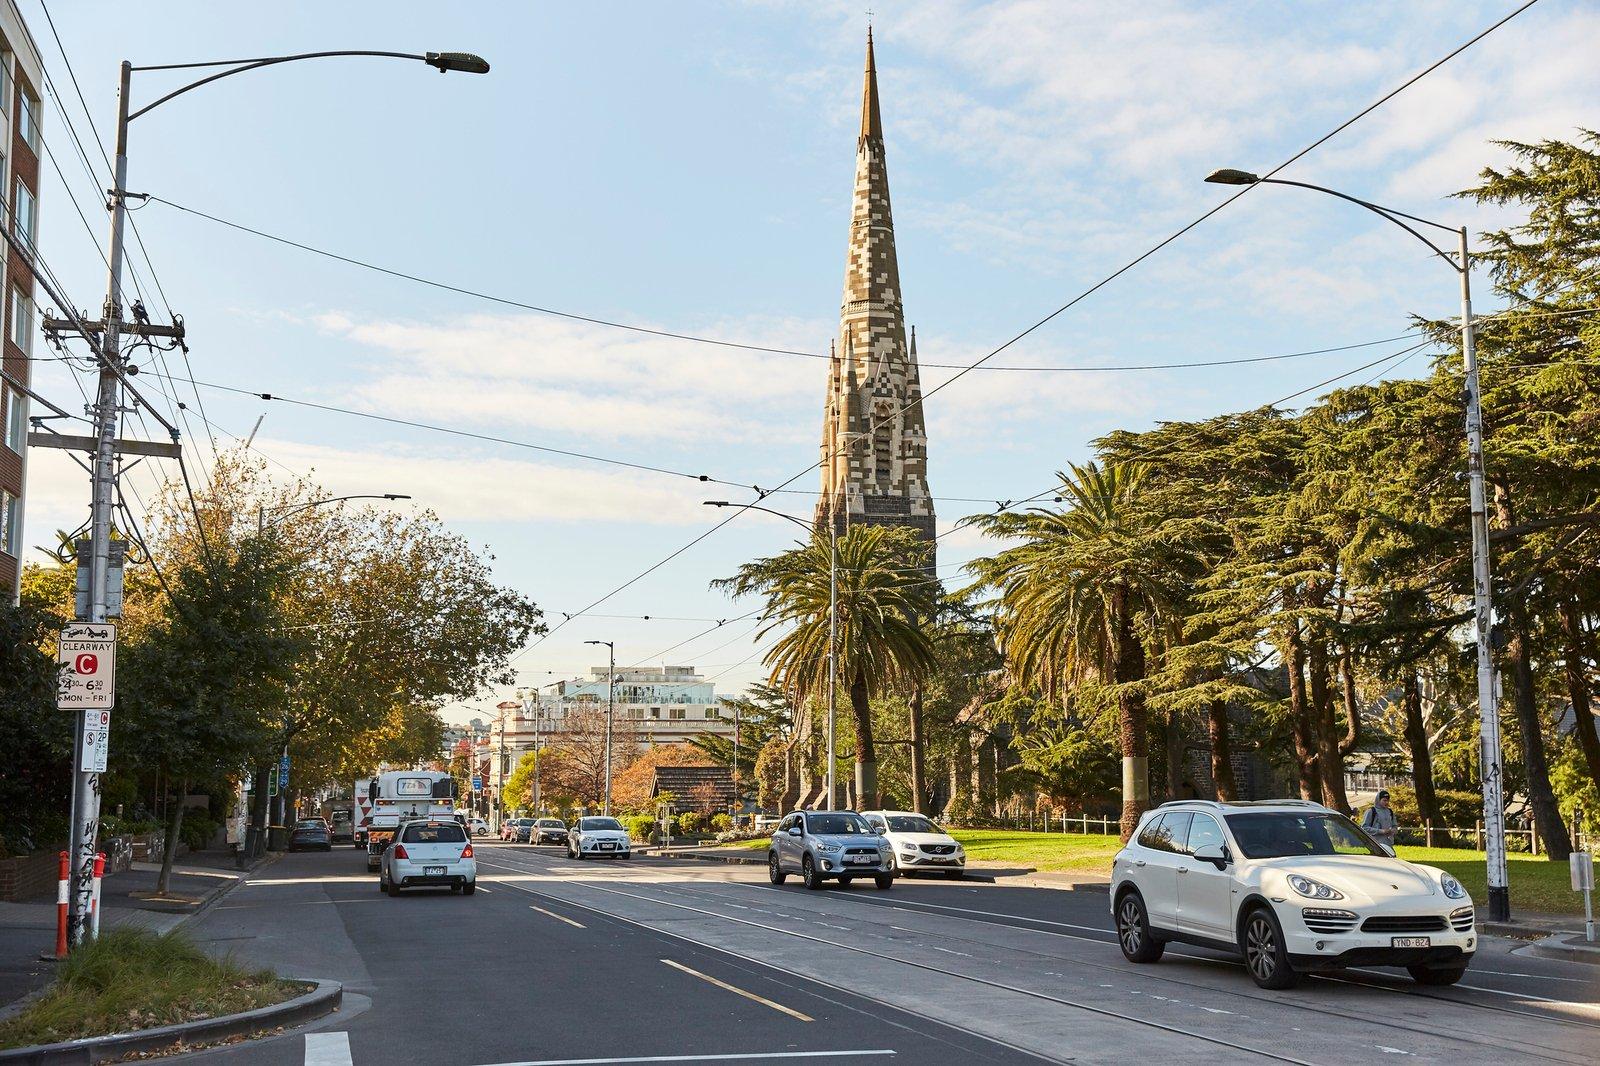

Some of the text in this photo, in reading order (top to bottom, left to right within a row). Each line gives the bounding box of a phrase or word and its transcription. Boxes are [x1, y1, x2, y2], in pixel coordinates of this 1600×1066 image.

[62, 642, 112, 651] CLEARWAY
[80, 655, 93, 674] C
[97, 732, 107, 742] 2P
